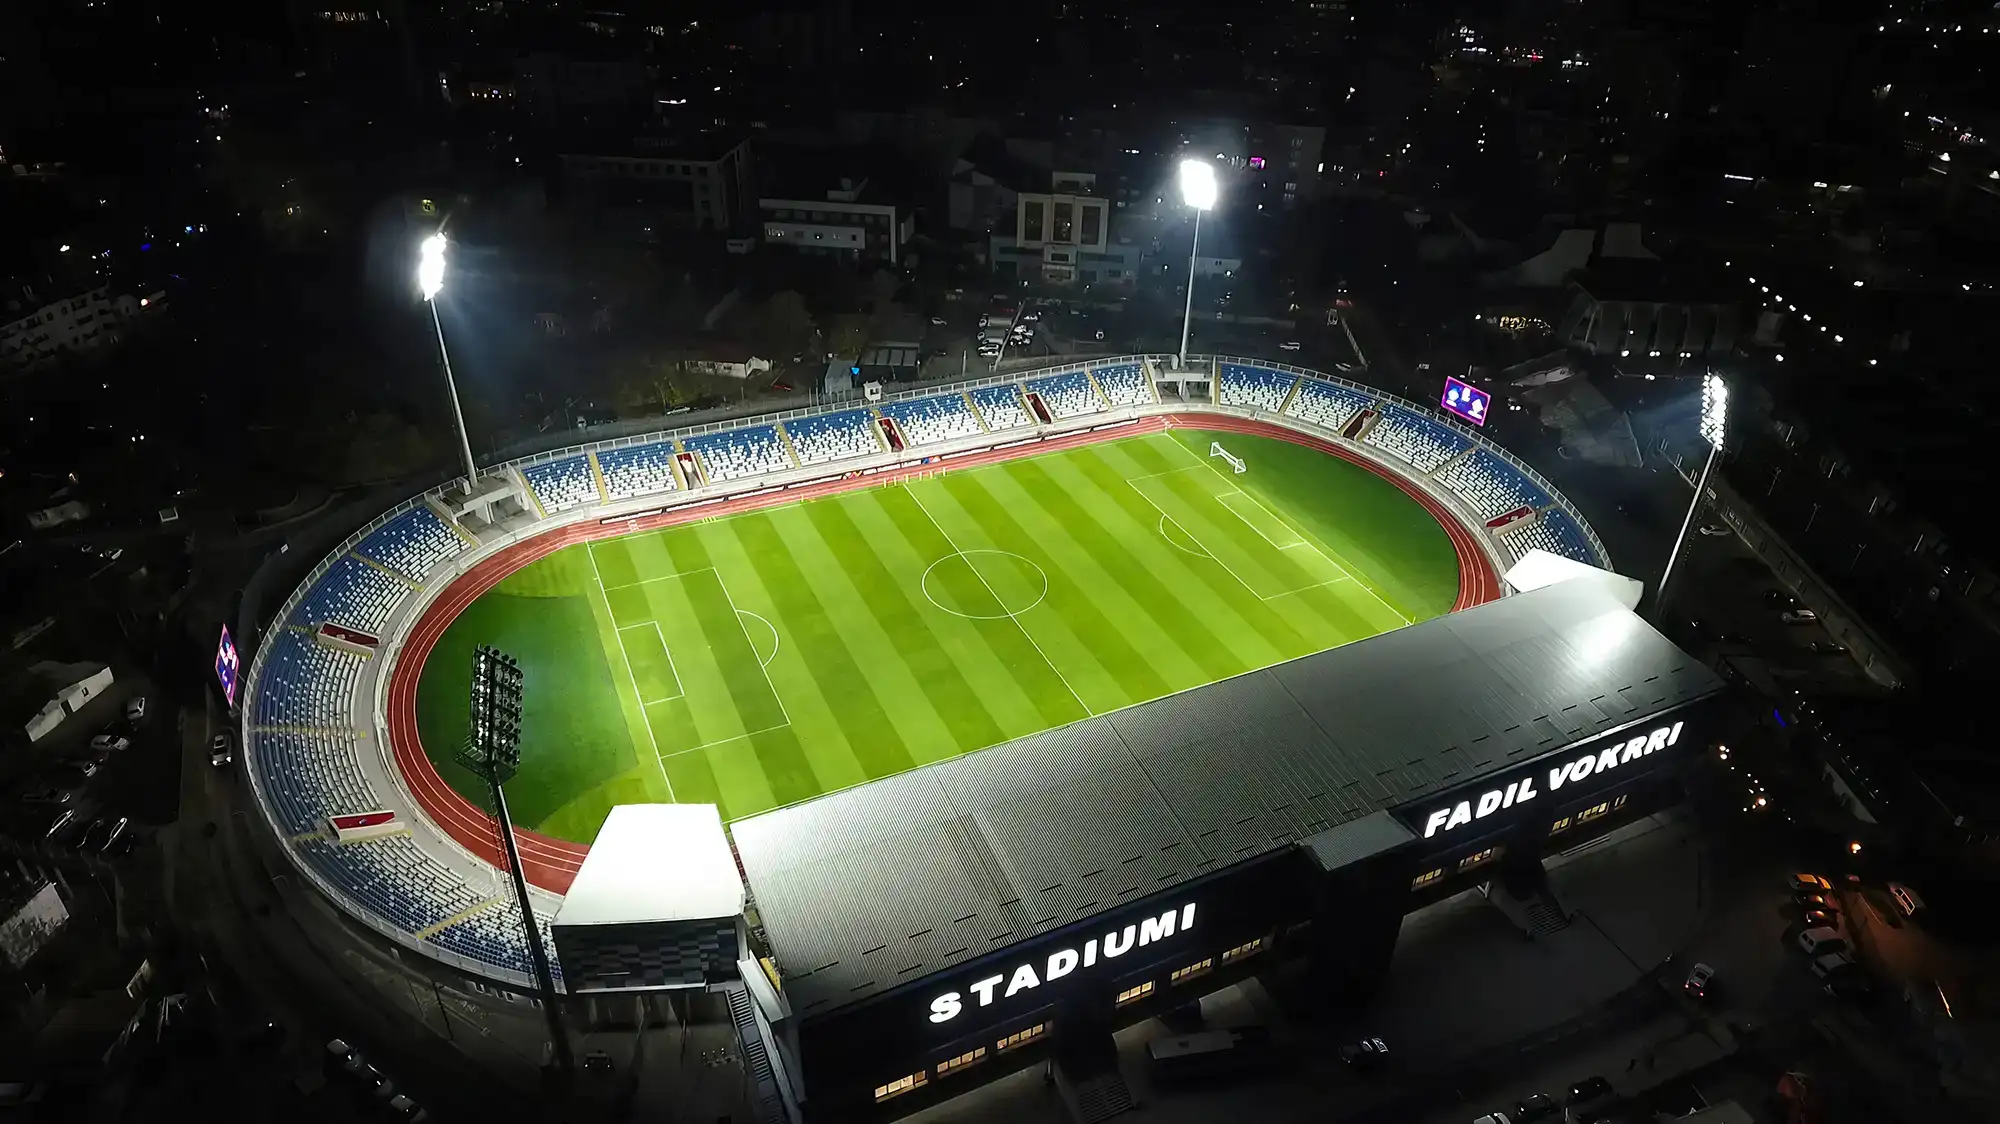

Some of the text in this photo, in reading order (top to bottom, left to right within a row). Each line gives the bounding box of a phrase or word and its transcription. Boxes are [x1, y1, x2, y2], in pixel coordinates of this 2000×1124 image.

[1424, 721, 1684, 839] FADIL VOKRRI
[929, 902, 1197, 1024] STADIUMI
